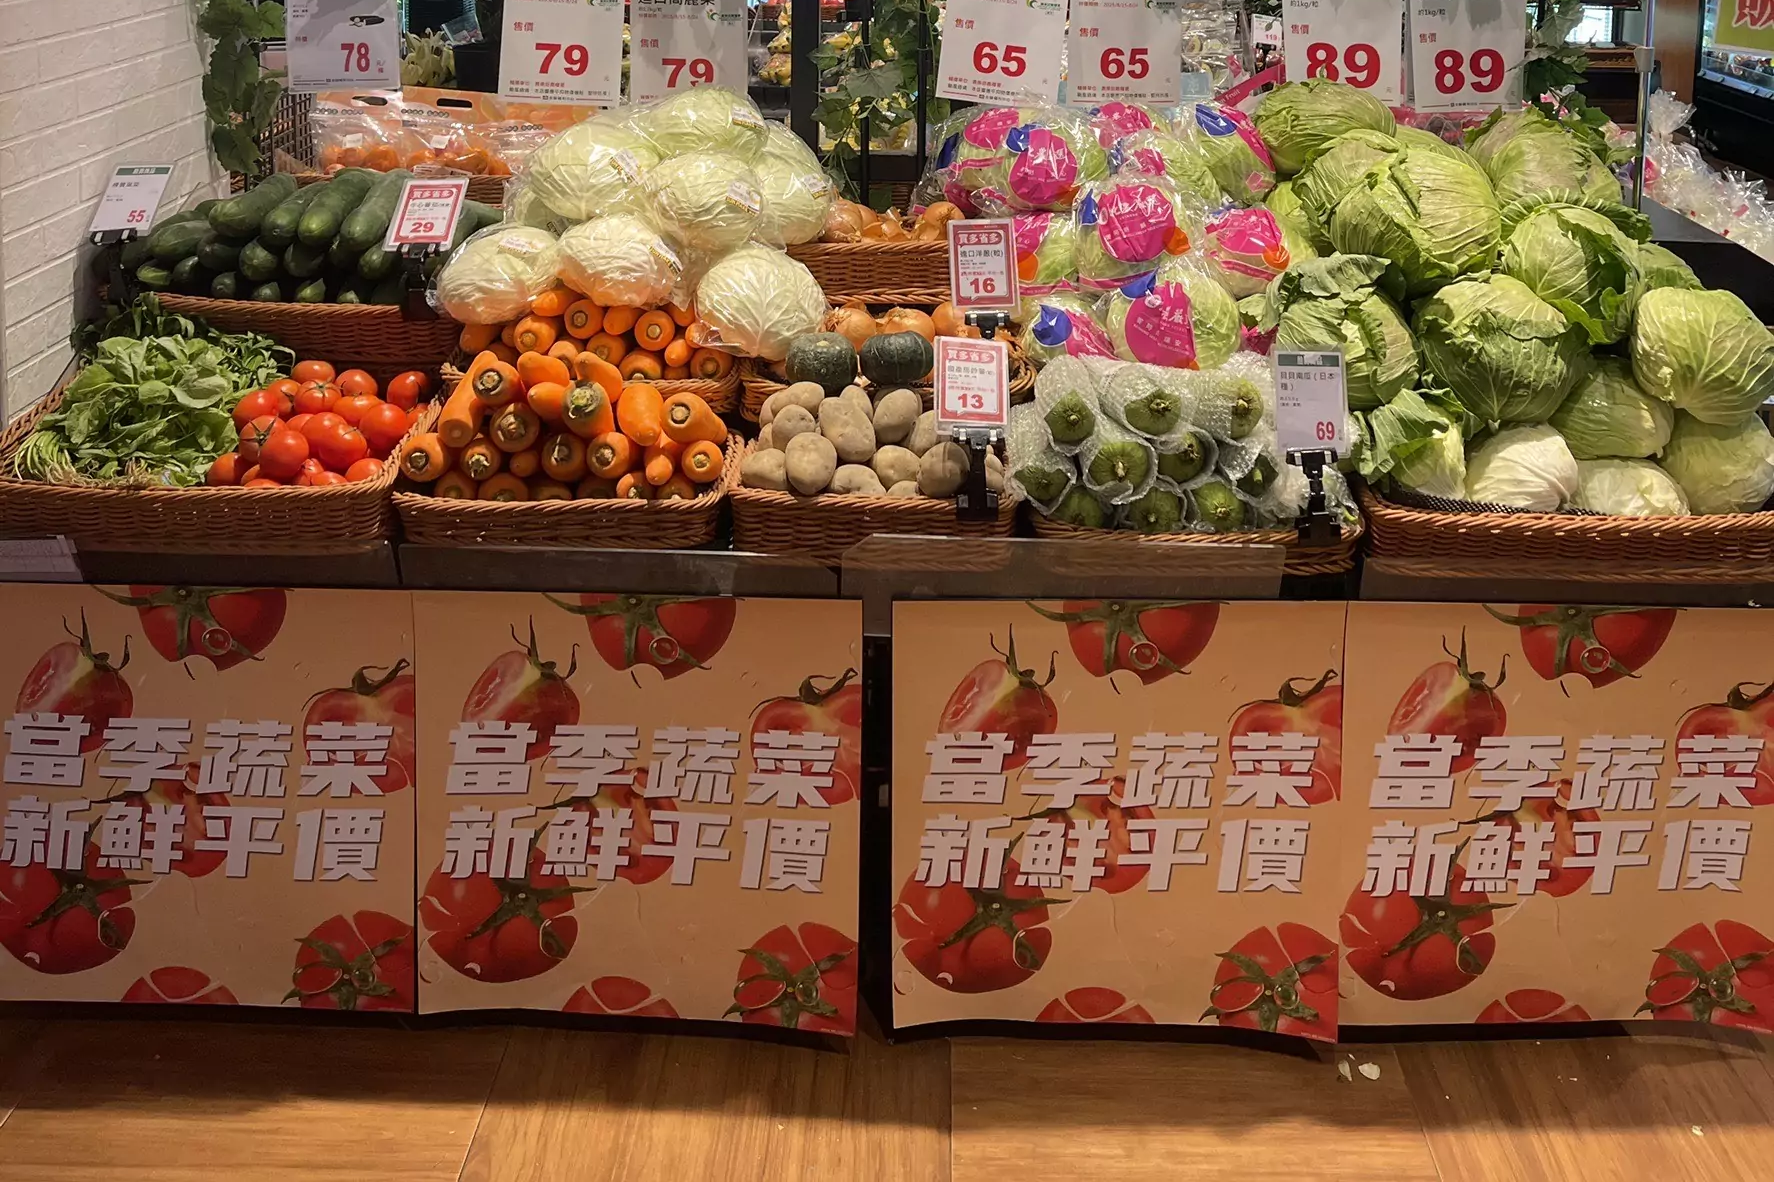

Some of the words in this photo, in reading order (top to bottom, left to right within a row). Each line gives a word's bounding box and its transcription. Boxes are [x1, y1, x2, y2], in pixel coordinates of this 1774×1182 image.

[513, 21, 534, 32] 售價
[955, 18, 975, 30] 售價
[1079, 28, 1099, 38] 售價
[1291, 24, 1309, 35] 售價
[1419, 33, 1437, 43] 售價
[341, 42, 370, 72] 78
[535, 42, 590, 76] 79
[640, 39, 659, 49] 售價
[972, 41, 1027, 78] 65
[662, 58, 714, 88] 79
[1100, 47, 1150, 80] 65
[1306, 42, 1380, 89] 89
[1434, 48, 1505, 94] 89
[127, 210, 146, 223] 55
[410, 222, 435, 233] 29
[970, 277, 996, 294] 16
[958, 393, 984, 409] 13
[1316, 421, 1335, 440] 69
[2, 712, 395, 799] 當季蔬菜
[446, 720, 841, 809] 當季蔬菜
[920, 731, 1322, 810] 當季蔬菜
[1368, 734, 1767, 813] 當季蔬菜
[0, 796, 385, 882] 新鮮平價
[441, 805, 831, 893] 新鮮平價
[914, 813, 1311, 895] 新鮮平價
[1361, 819, 1753, 897] 新鮮平價
